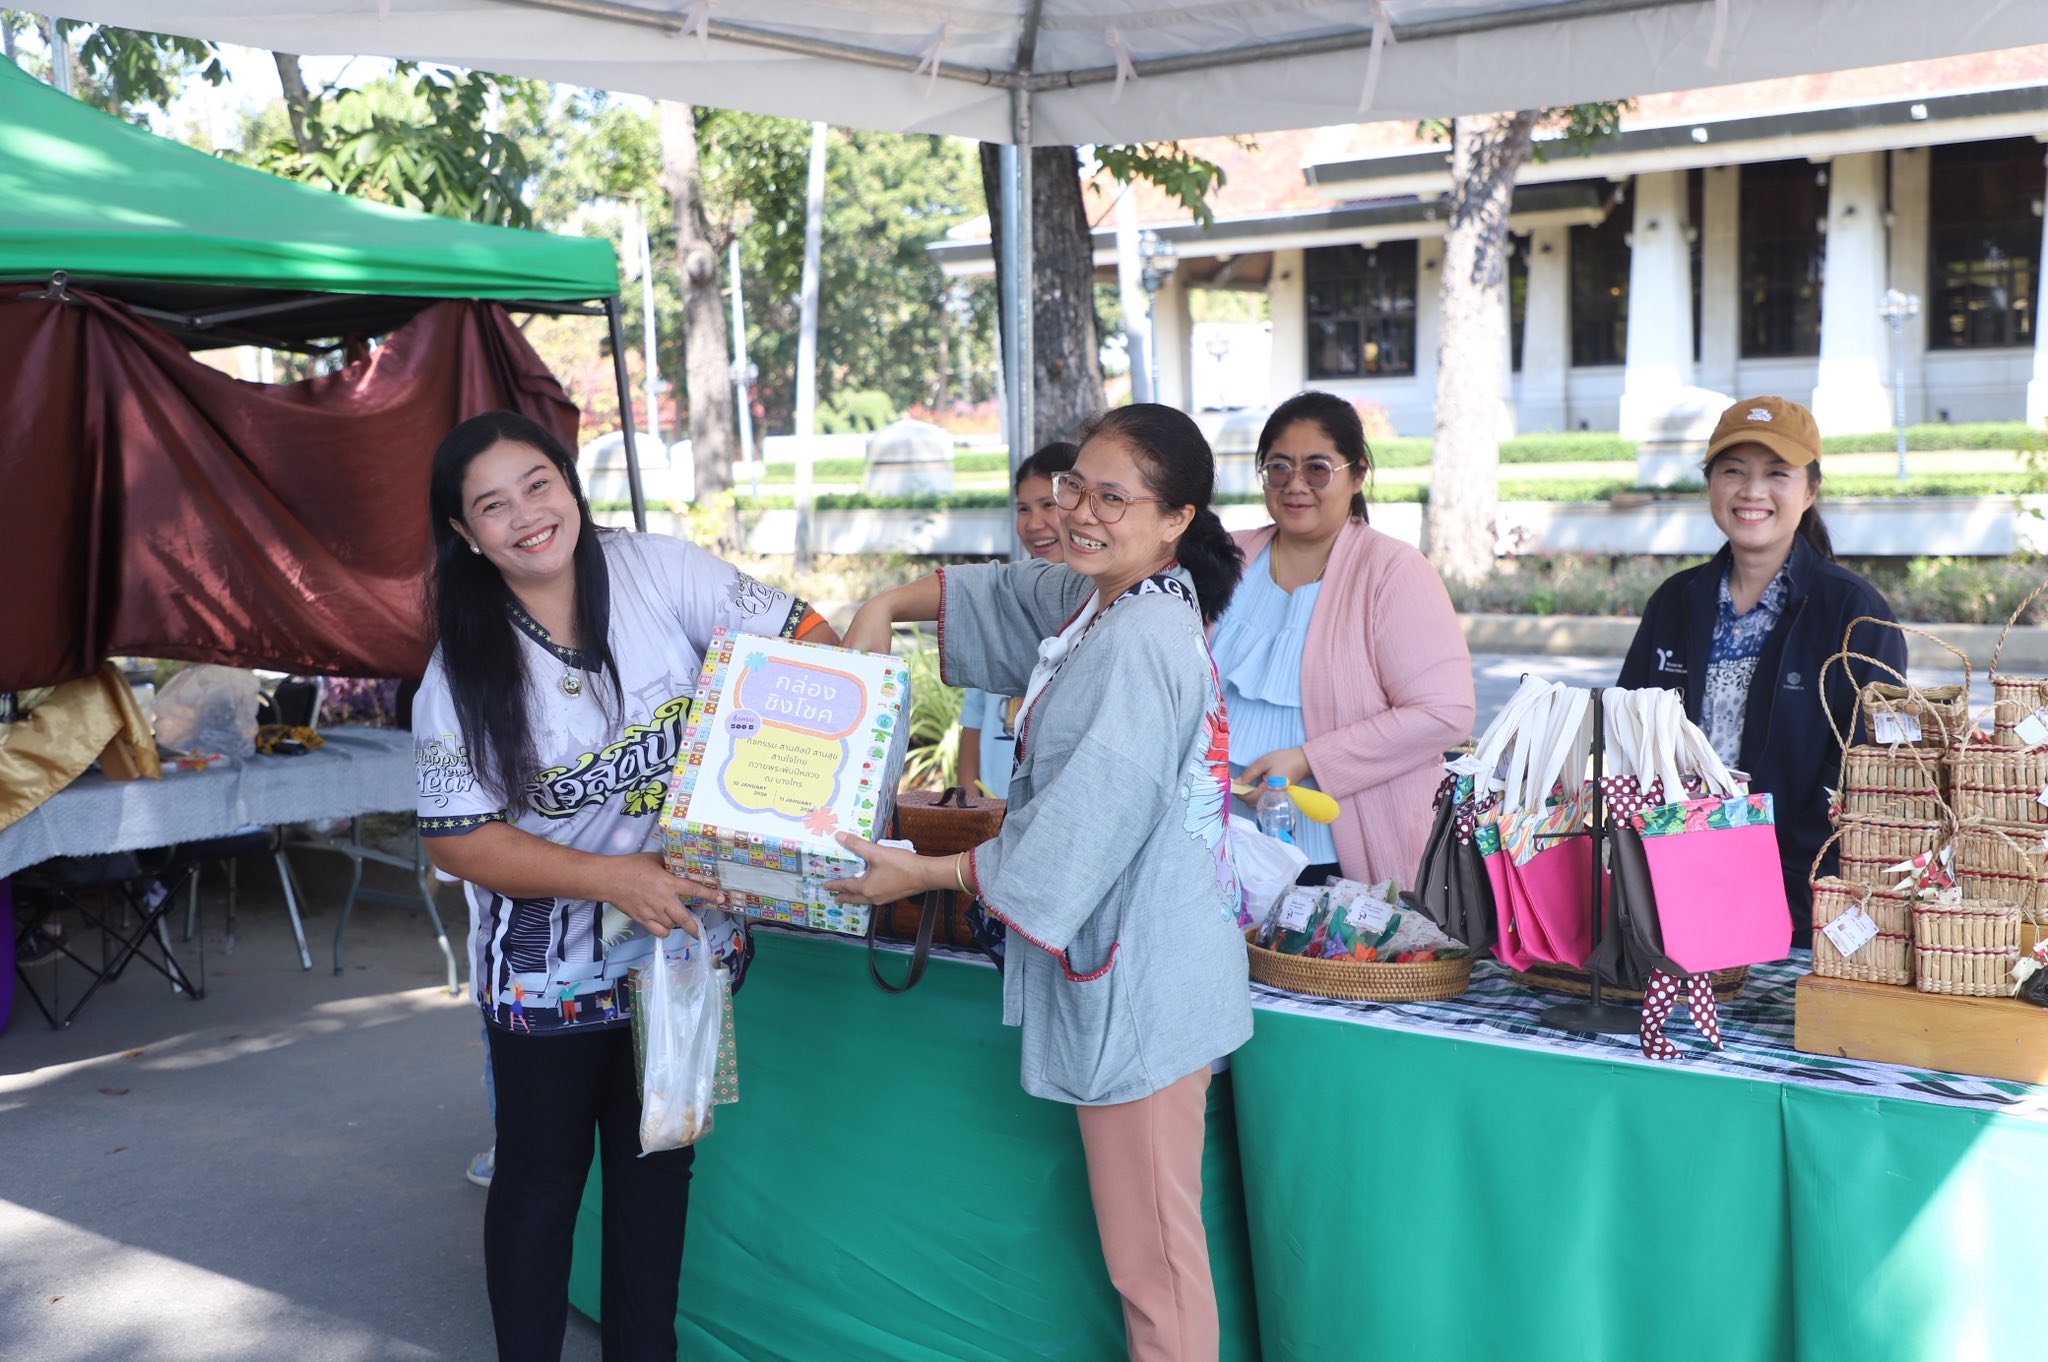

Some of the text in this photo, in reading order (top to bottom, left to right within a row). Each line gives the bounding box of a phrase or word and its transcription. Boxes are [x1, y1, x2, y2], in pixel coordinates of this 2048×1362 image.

[775, 675, 836, 701] กล่อง
[765, 693, 833, 724] ชิงโชค
[746, 737, 778, 749] กิจกรรม
[417, 765, 475, 798] Year
[740, 781, 767, 790] JANUARY
[775, 777, 804, 788] บางไทร
[785, 797, 812, 806] JANUARY
